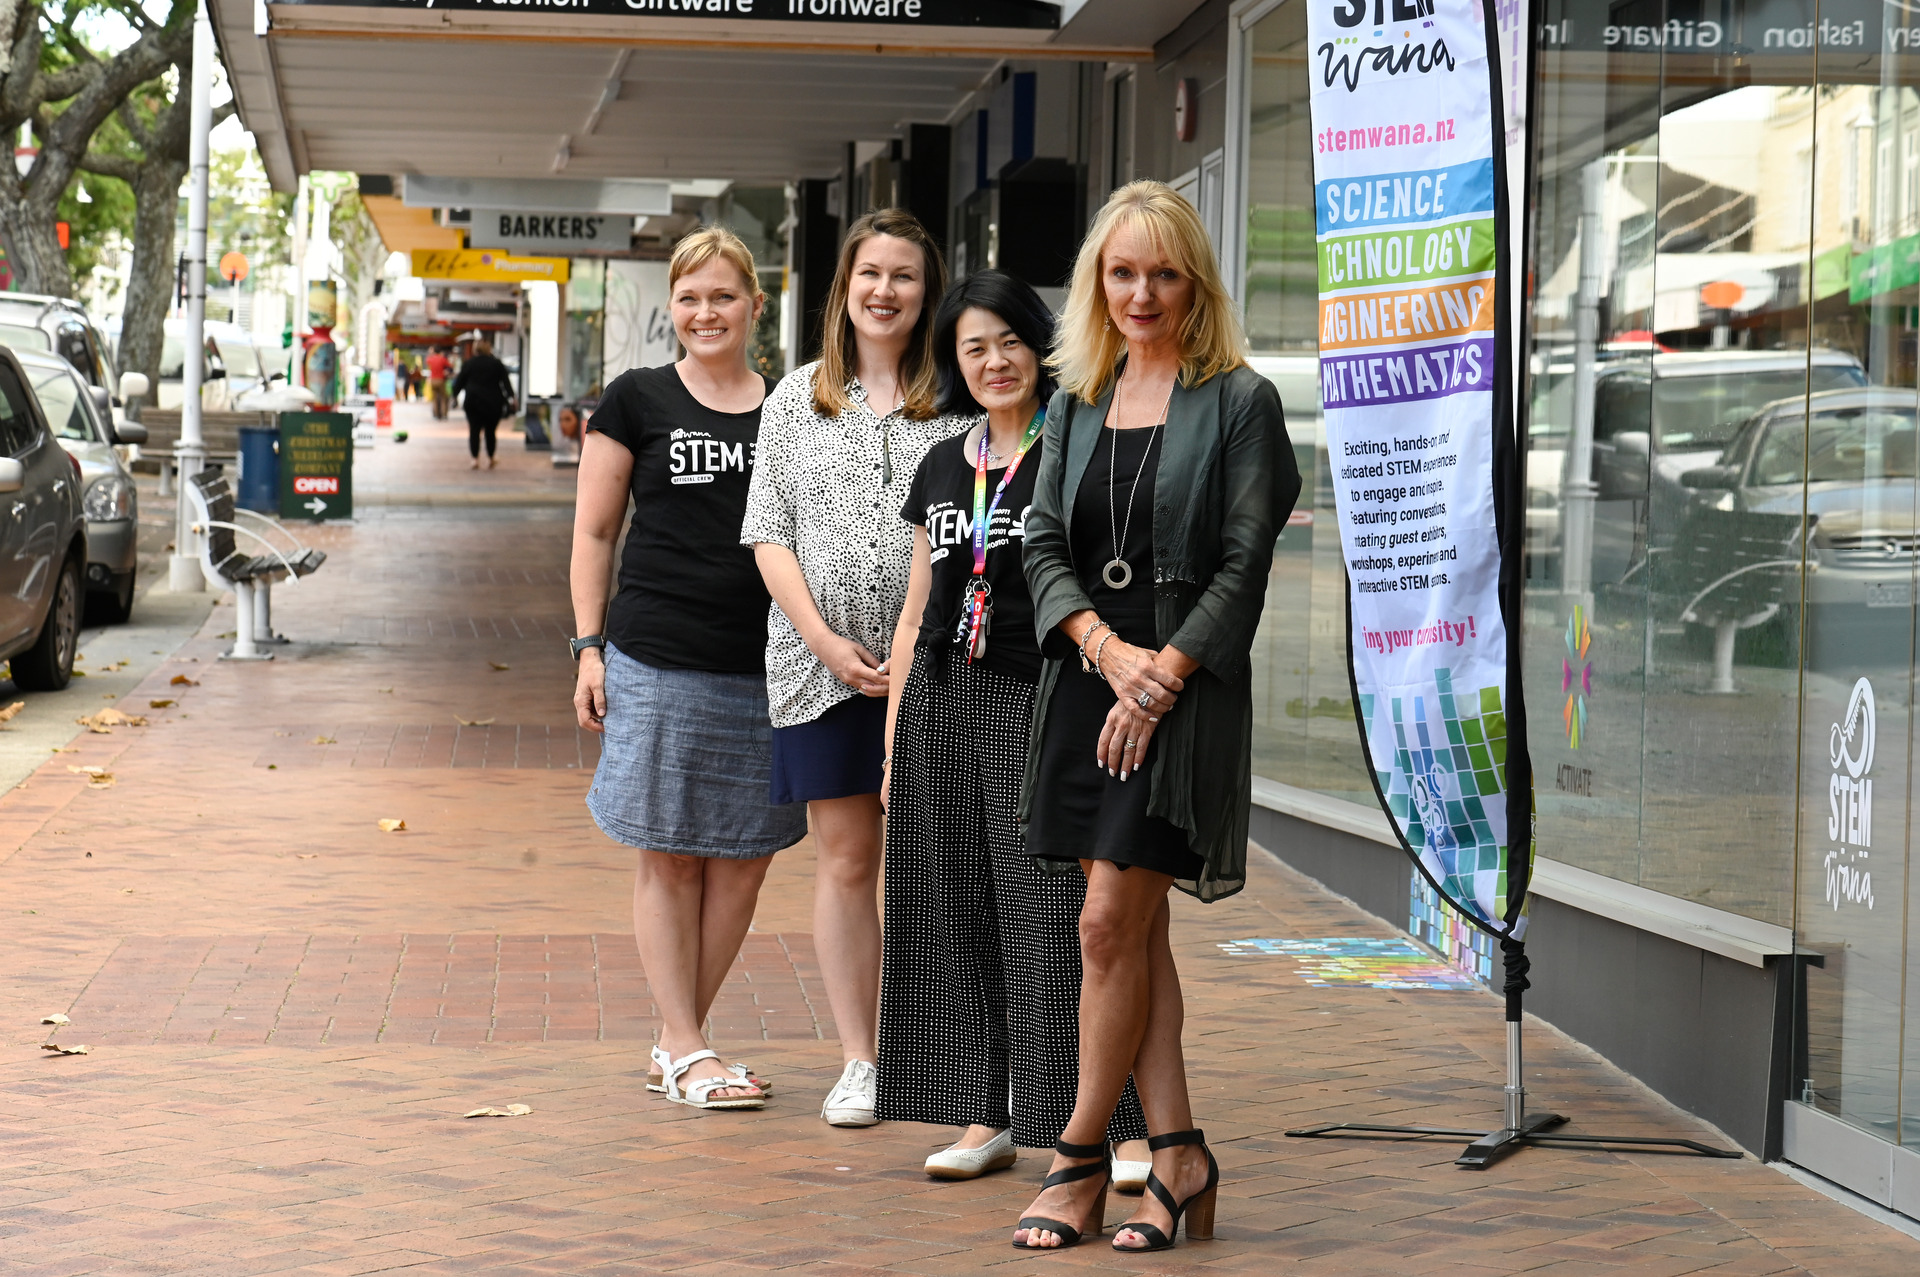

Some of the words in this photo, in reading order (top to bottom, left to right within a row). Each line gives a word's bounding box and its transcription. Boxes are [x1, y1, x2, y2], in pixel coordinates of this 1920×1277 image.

[1318, 119, 1456, 153] stemwana.nz
[1326, 173, 1448, 224] SCIENCE
[494, 259, 554, 276] Pharmacy
[669, 440, 744, 474] STEM
[1345, 440, 1391, 457] Exciting,
[1387, 459, 1421, 476] STEM
[295, 478, 338, 492] OPEN
[1351, 489, 1360, 502] to
[1363, 485, 1406, 503] engage
[1389, 530, 1418, 548] guest
[1440, 545, 1457, 560] and
[1400, 575, 1429, 590] STEM
[1385, 629, 1413, 653] your
[1556, 763, 1592, 797] ACTIVATE
[1828, 773, 1872, 847] STEM
